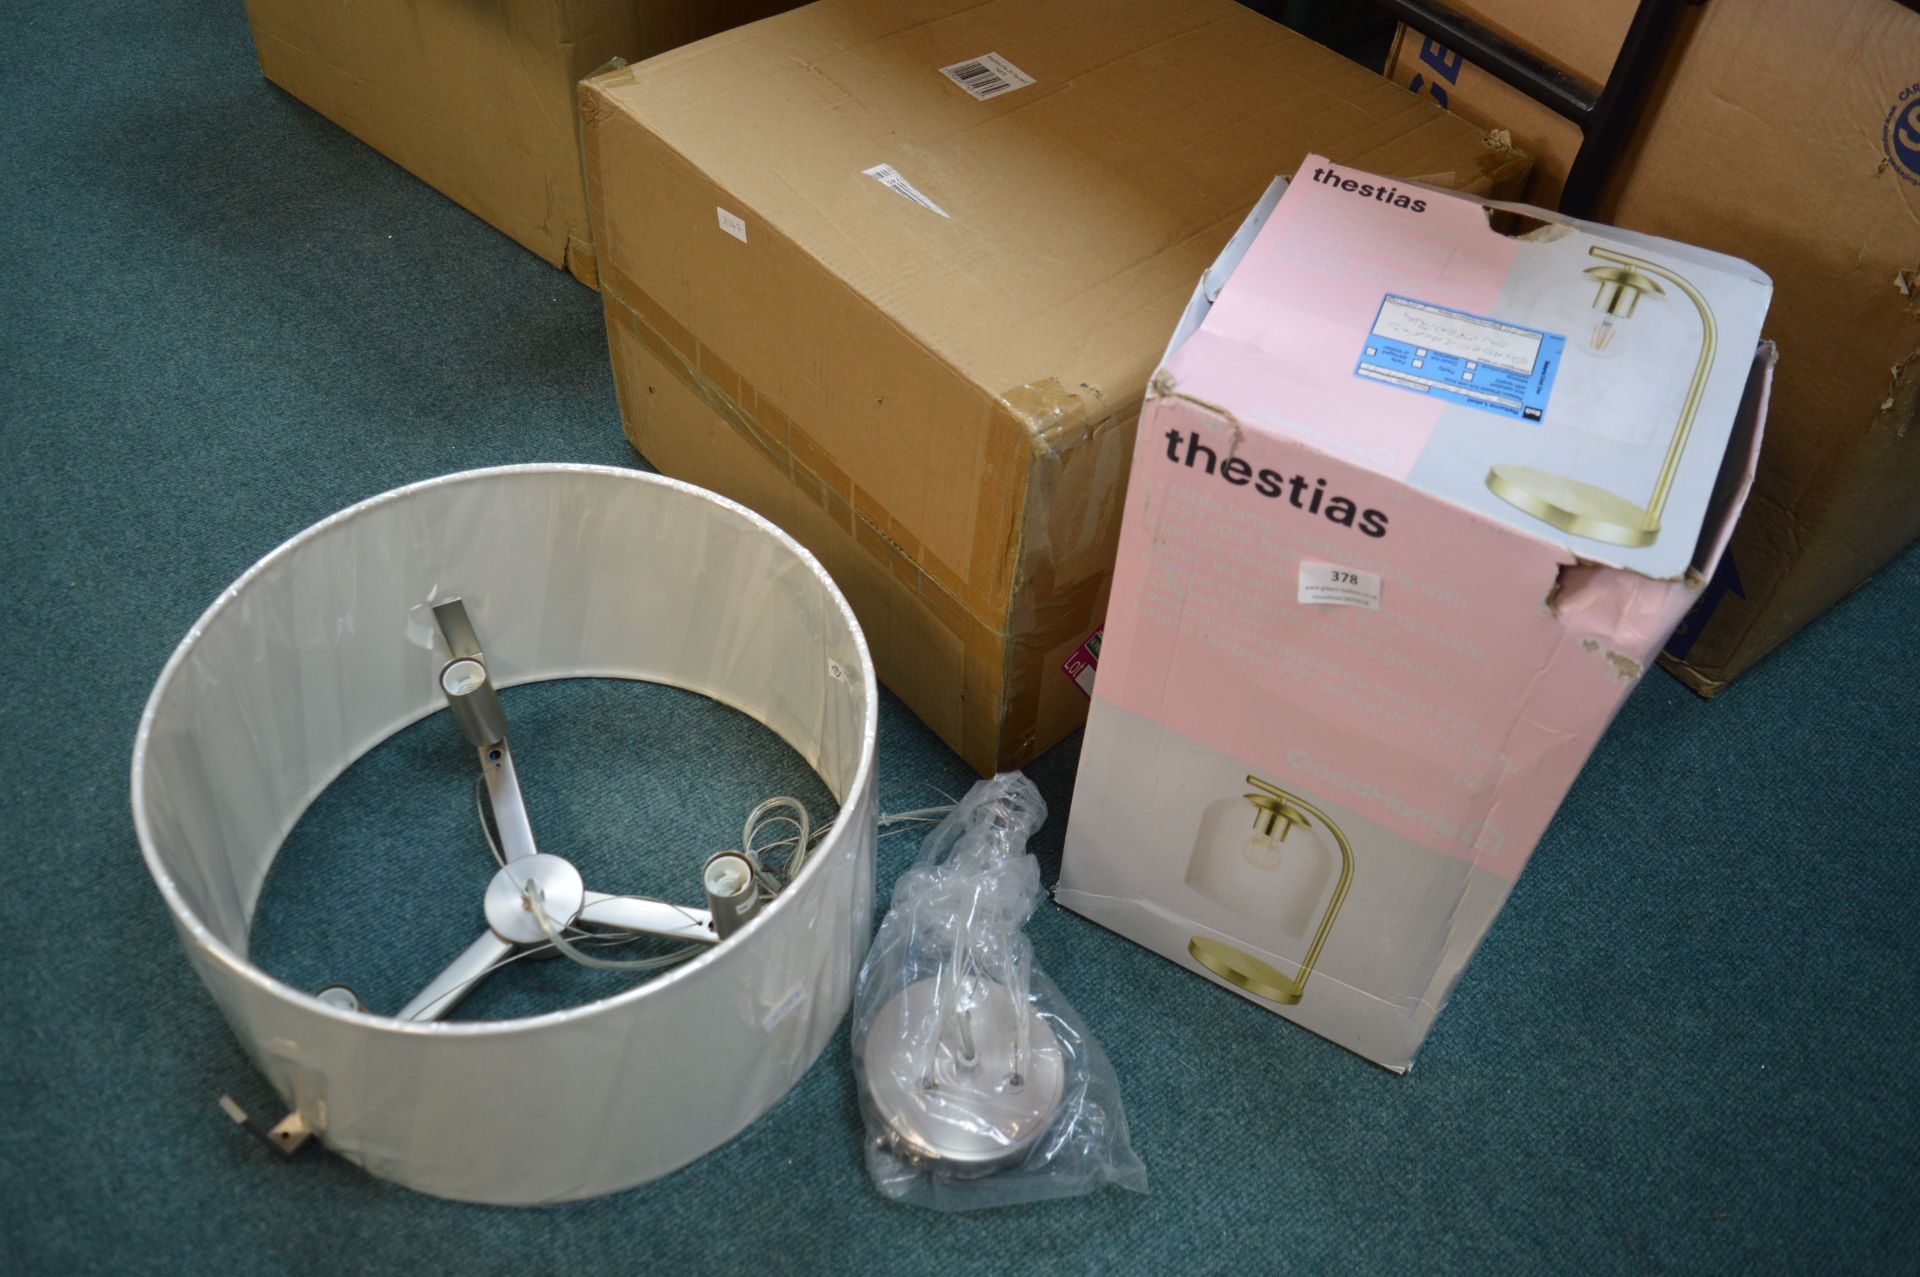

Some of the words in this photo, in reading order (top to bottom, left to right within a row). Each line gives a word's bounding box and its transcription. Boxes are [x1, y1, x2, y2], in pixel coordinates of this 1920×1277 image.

[1313, 167, 1428, 213] thestias
[1165, 428, 1389, 538] thestias
[1331, 571, 1359, 585] 378
